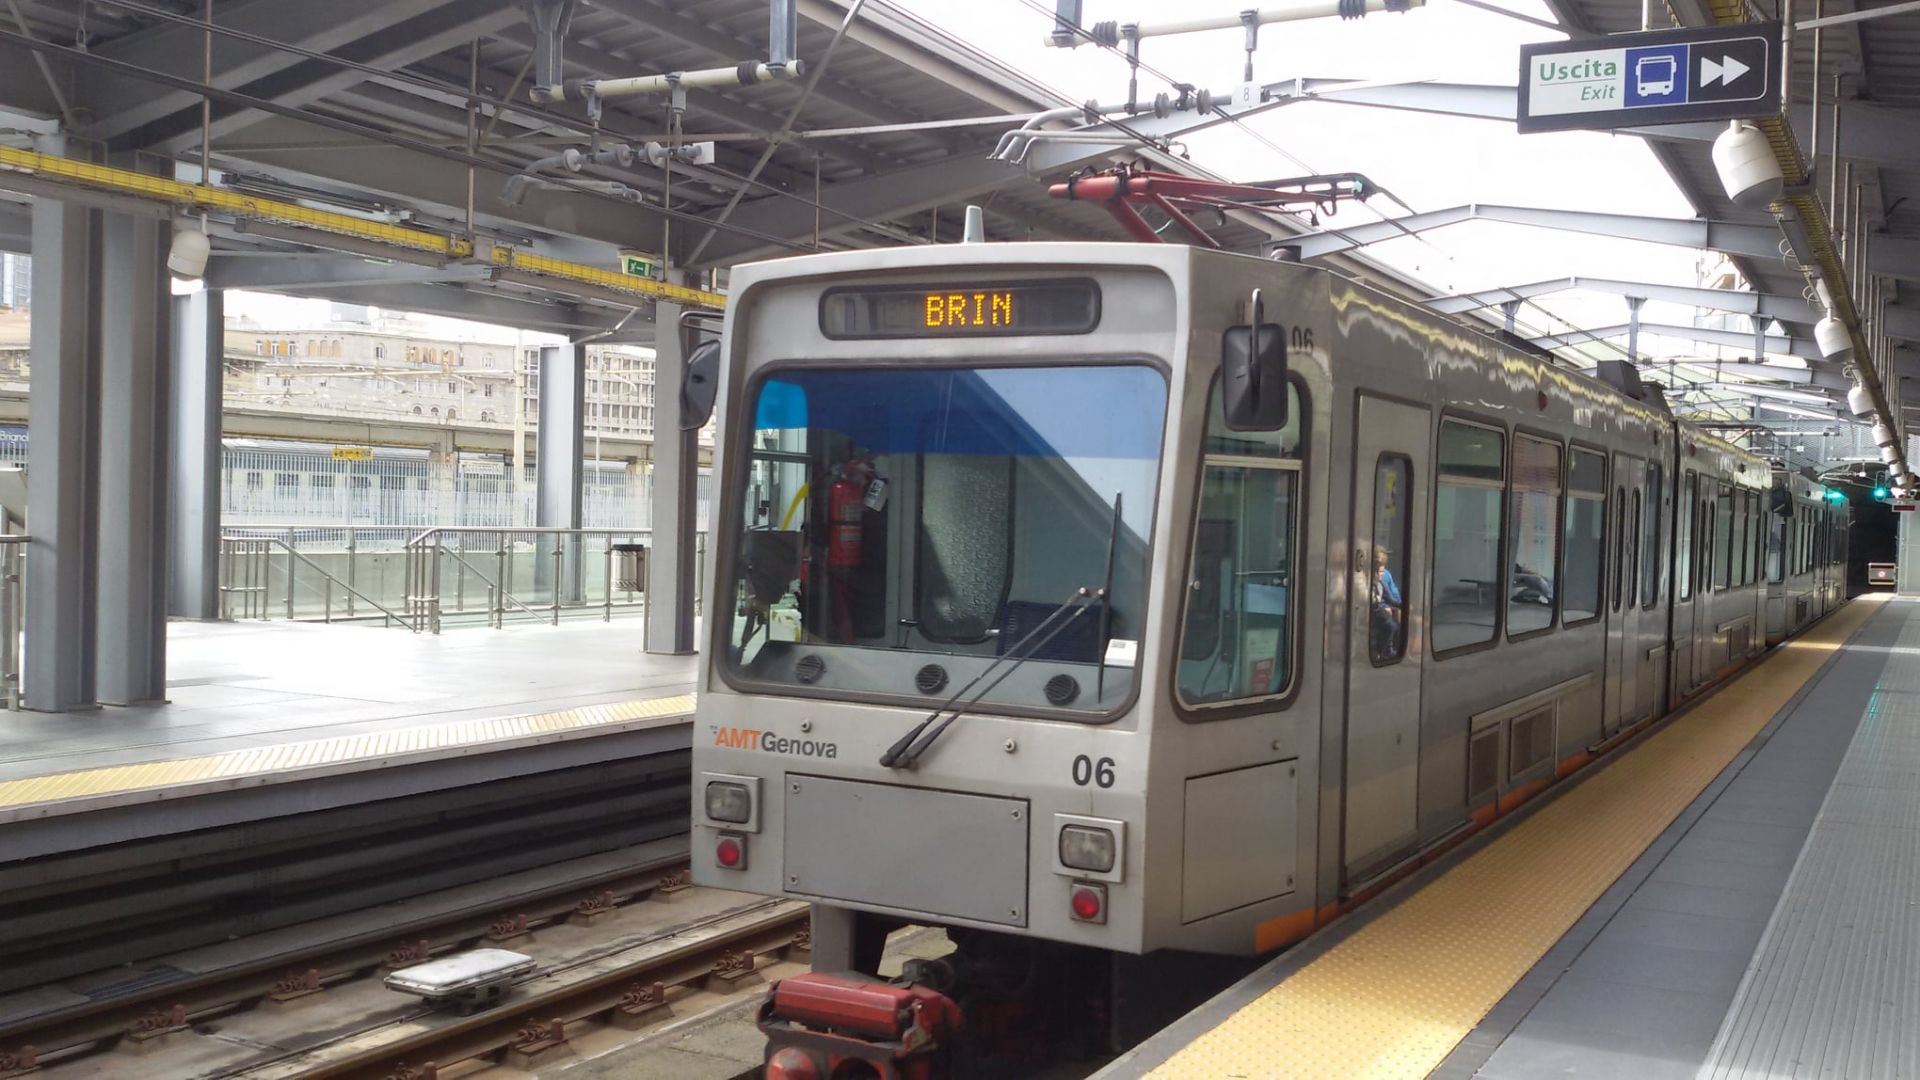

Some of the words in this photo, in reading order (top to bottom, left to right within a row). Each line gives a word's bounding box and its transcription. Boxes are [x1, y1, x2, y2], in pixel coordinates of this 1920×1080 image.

[1539, 59, 1617, 81] Uscita
[1243, 87, 1250, 101] 8
[1581, 85, 1616, 101] Exit
[926, 293, 1012, 327] BRIN
[1291, 325, 1314, 356] 06
[0, 430, 29, 443] Brignol
[1072, 754, 1116, 789] 06
